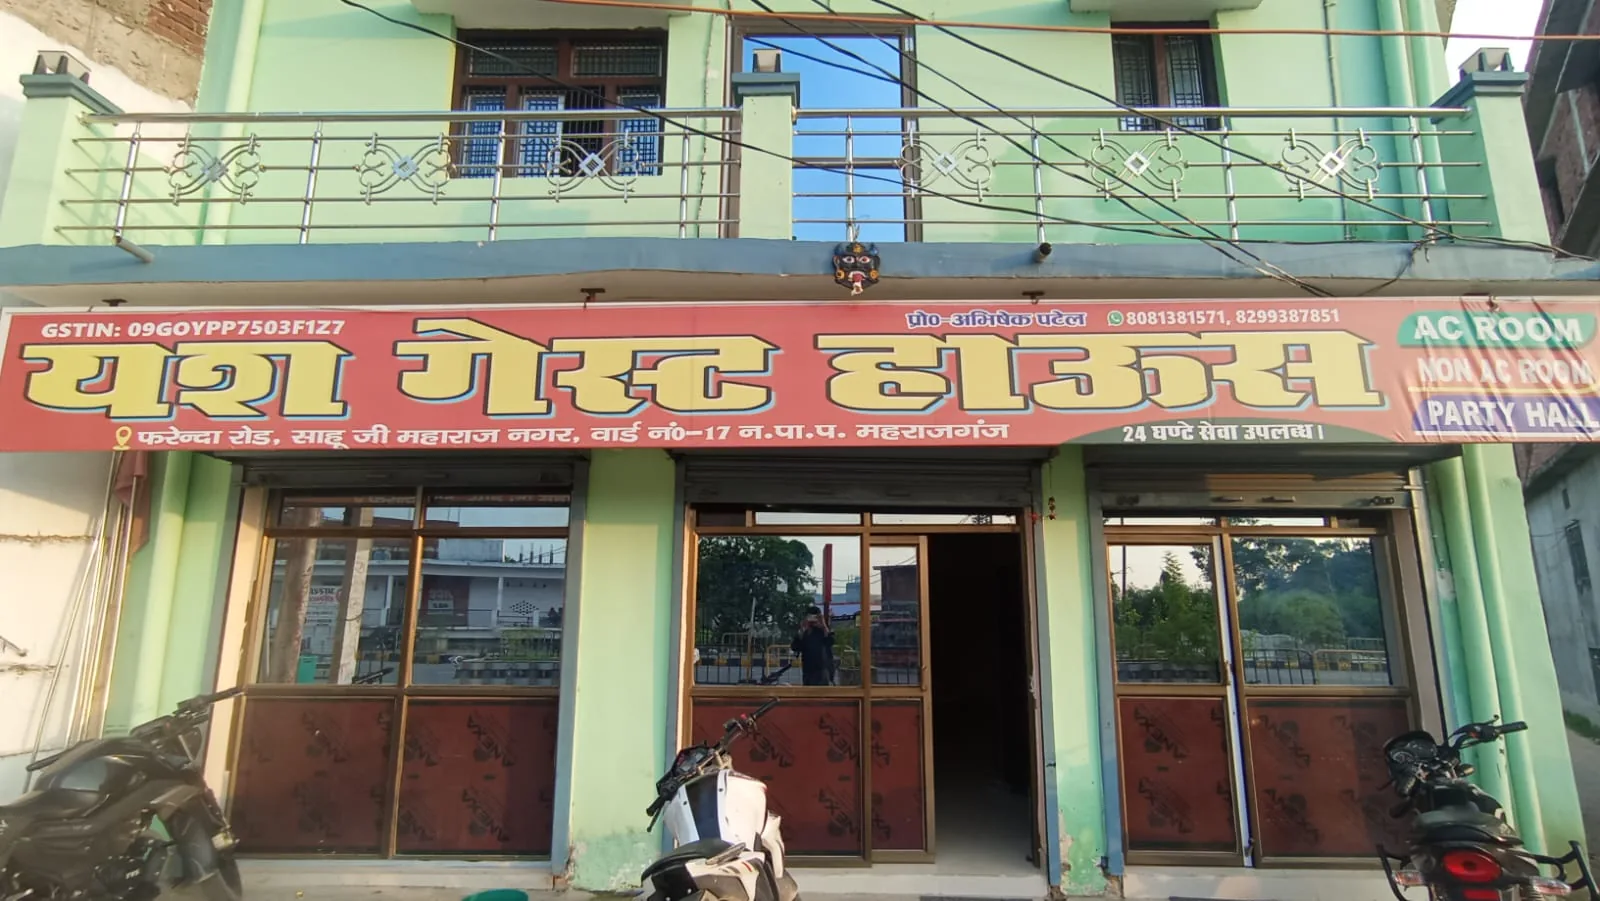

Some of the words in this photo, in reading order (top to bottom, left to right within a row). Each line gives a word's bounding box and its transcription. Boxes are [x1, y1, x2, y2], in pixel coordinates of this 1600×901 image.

[41, 322, 121, 338] GSTIN:
[127, 319, 345, 337] 09GOYPP7503F1Z7
[1035, 310, 1087, 326] पटेल
[1126, 310, 1231, 326] 8081381571,
[1236, 308, 1340, 324] 8299387851
[1414, 316, 1464, 340] AC
[1474, 317, 1584, 342] ROOM
[20, 341, 355, 421] यश
[393, 317, 784, 419] गेस्ट
[814, 333, 1390, 415] हाऊस
[1417, 357, 1473, 382] NON
[1480, 359, 1512, 383] AC
[1518, 359, 1598, 385] ROOM
[1427, 400, 1515, 427] PARTY
[1524, 402, 1600, 428] HALL
[137, 425, 223, 446] फरेन्दा
[228, 425, 281, 446] रोड,
[290, 428, 349, 449] साहू
[352, 424, 391, 444] जी
[396, 428, 501, 446] महाराज
[507, 427, 580, 444] नगर,
[590, 421, 642, 443] वार्ड
[855, 419, 1010, 441] महराजगंज
[1123, 425, 1147, 443] 24
[1199, 421, 1239, 440] सेवा
